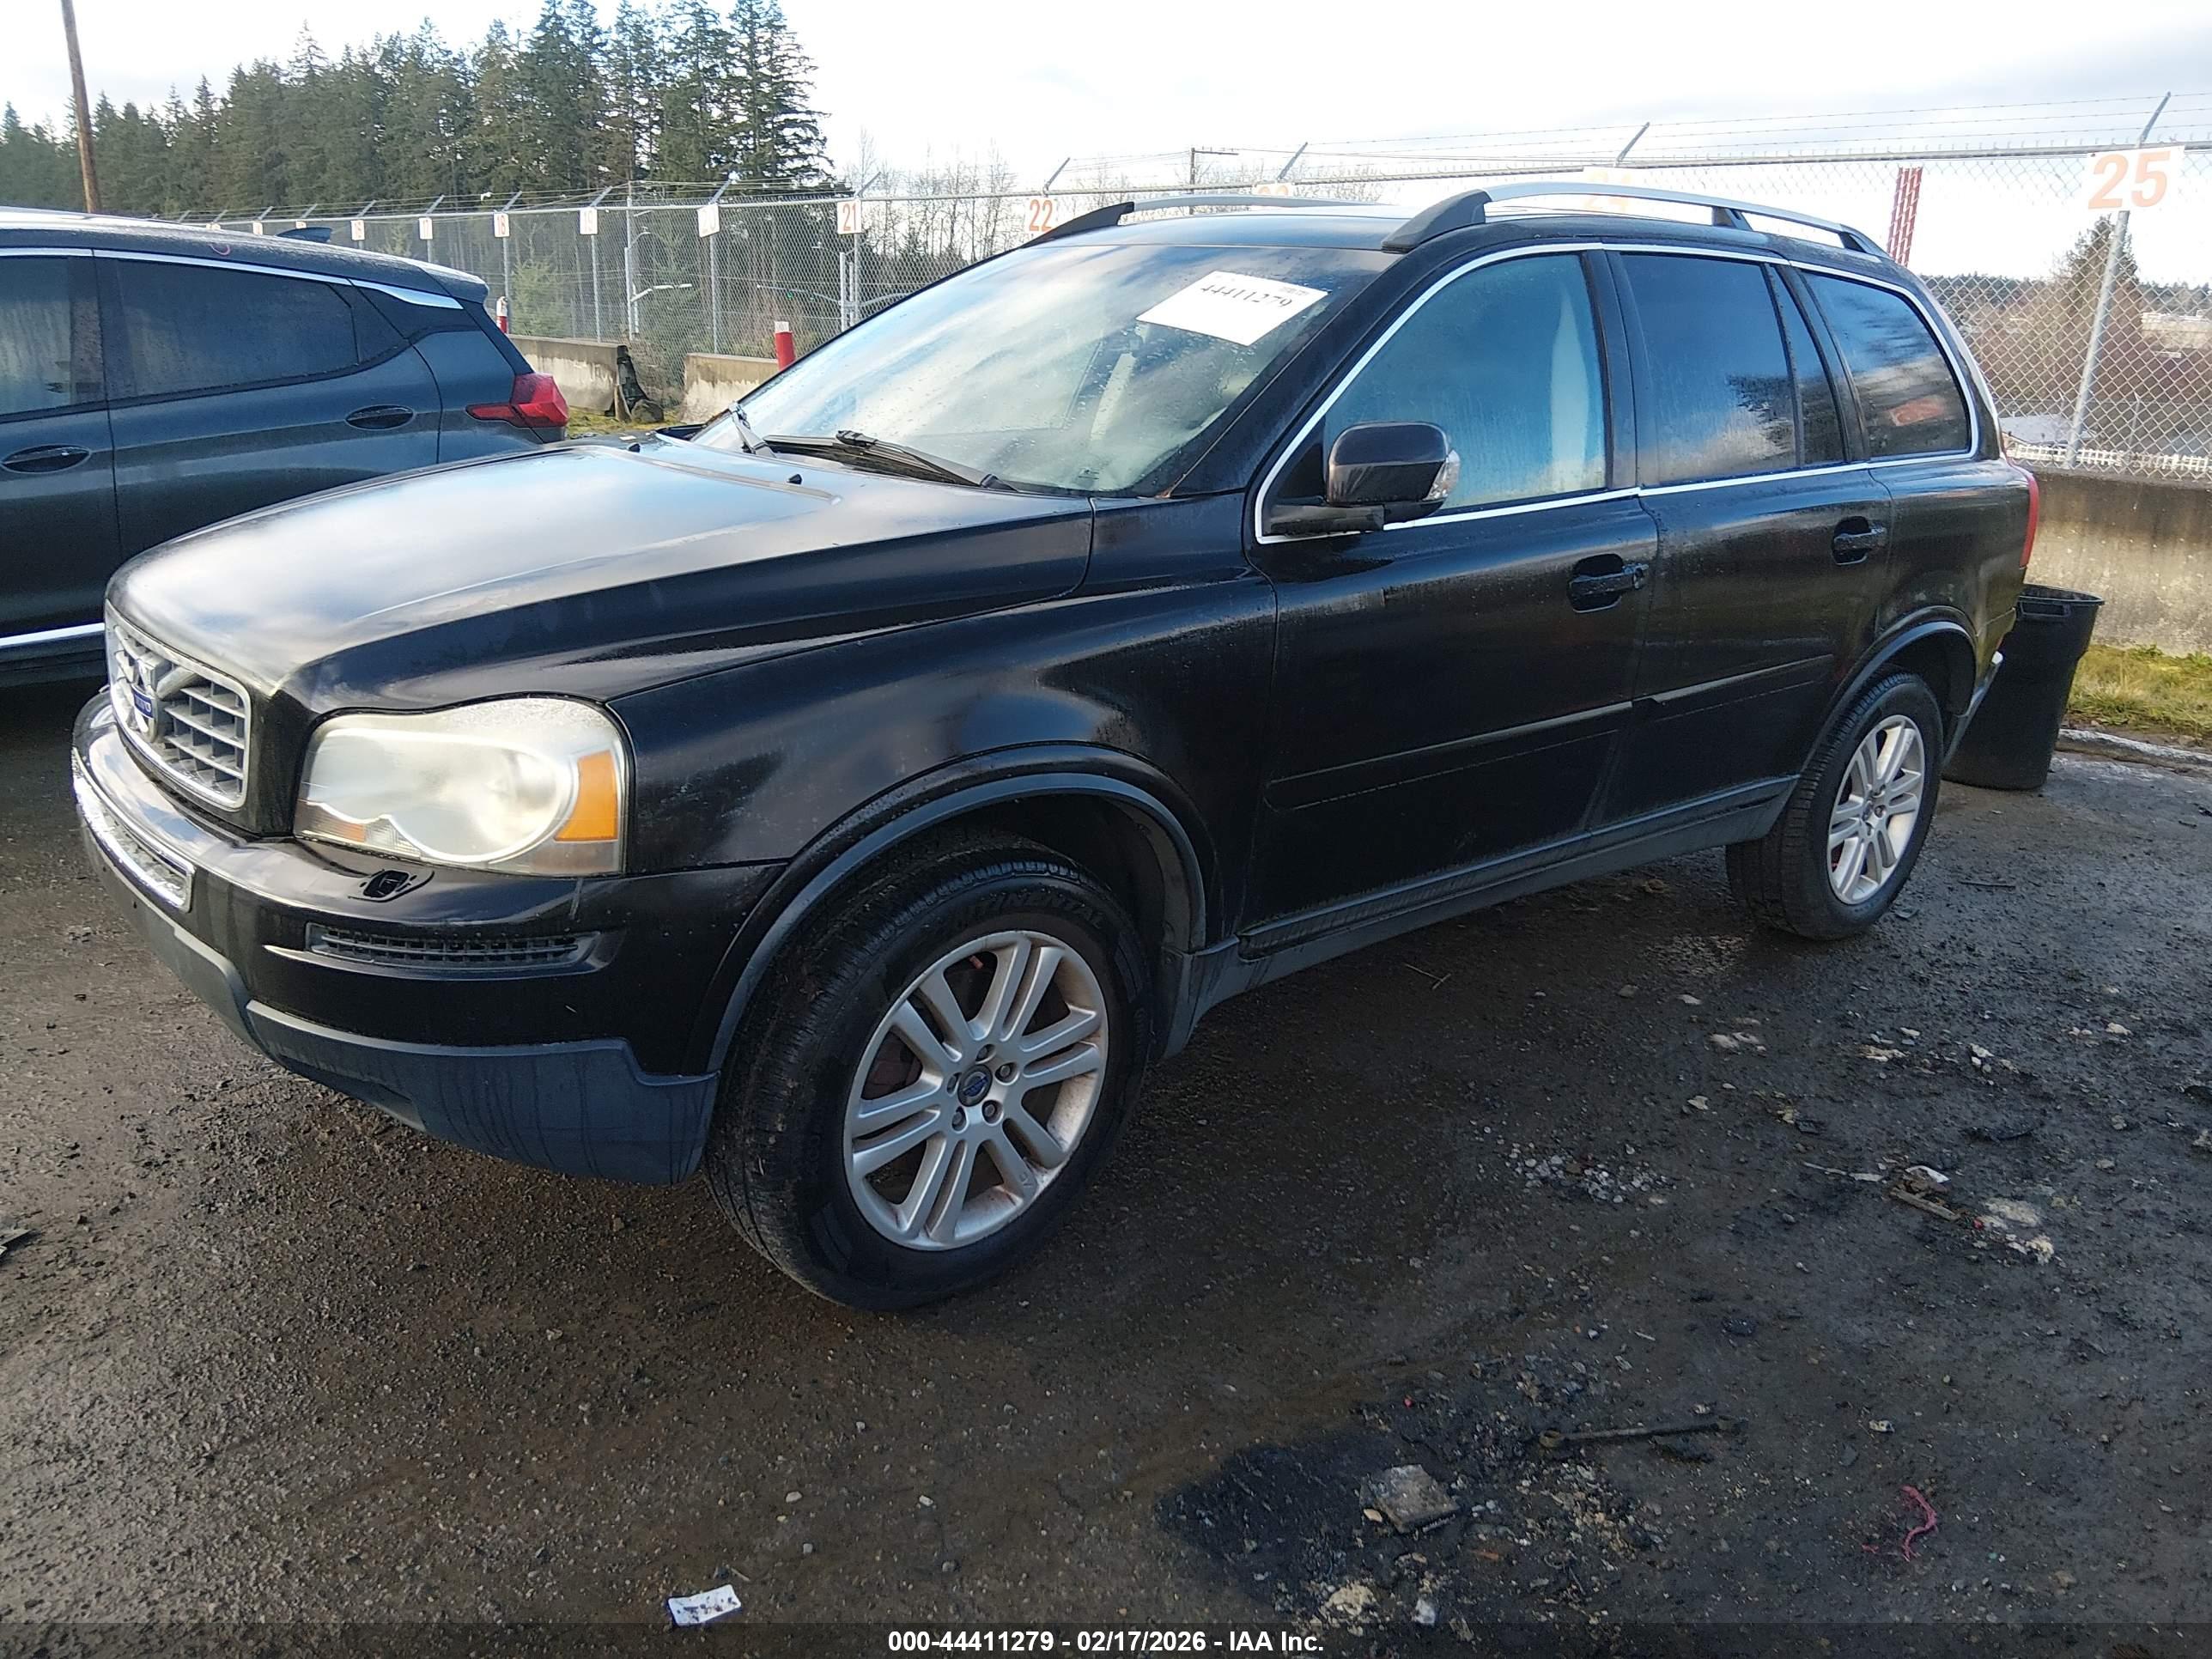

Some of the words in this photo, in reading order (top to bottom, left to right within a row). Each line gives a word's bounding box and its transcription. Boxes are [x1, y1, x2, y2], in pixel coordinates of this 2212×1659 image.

[2088, 150, 2172, 210] 25
[842, 202, 857, 231] 21
[1030, 199, 1053, 232] 22
[1200, 284, 1292, 307] 44411279
